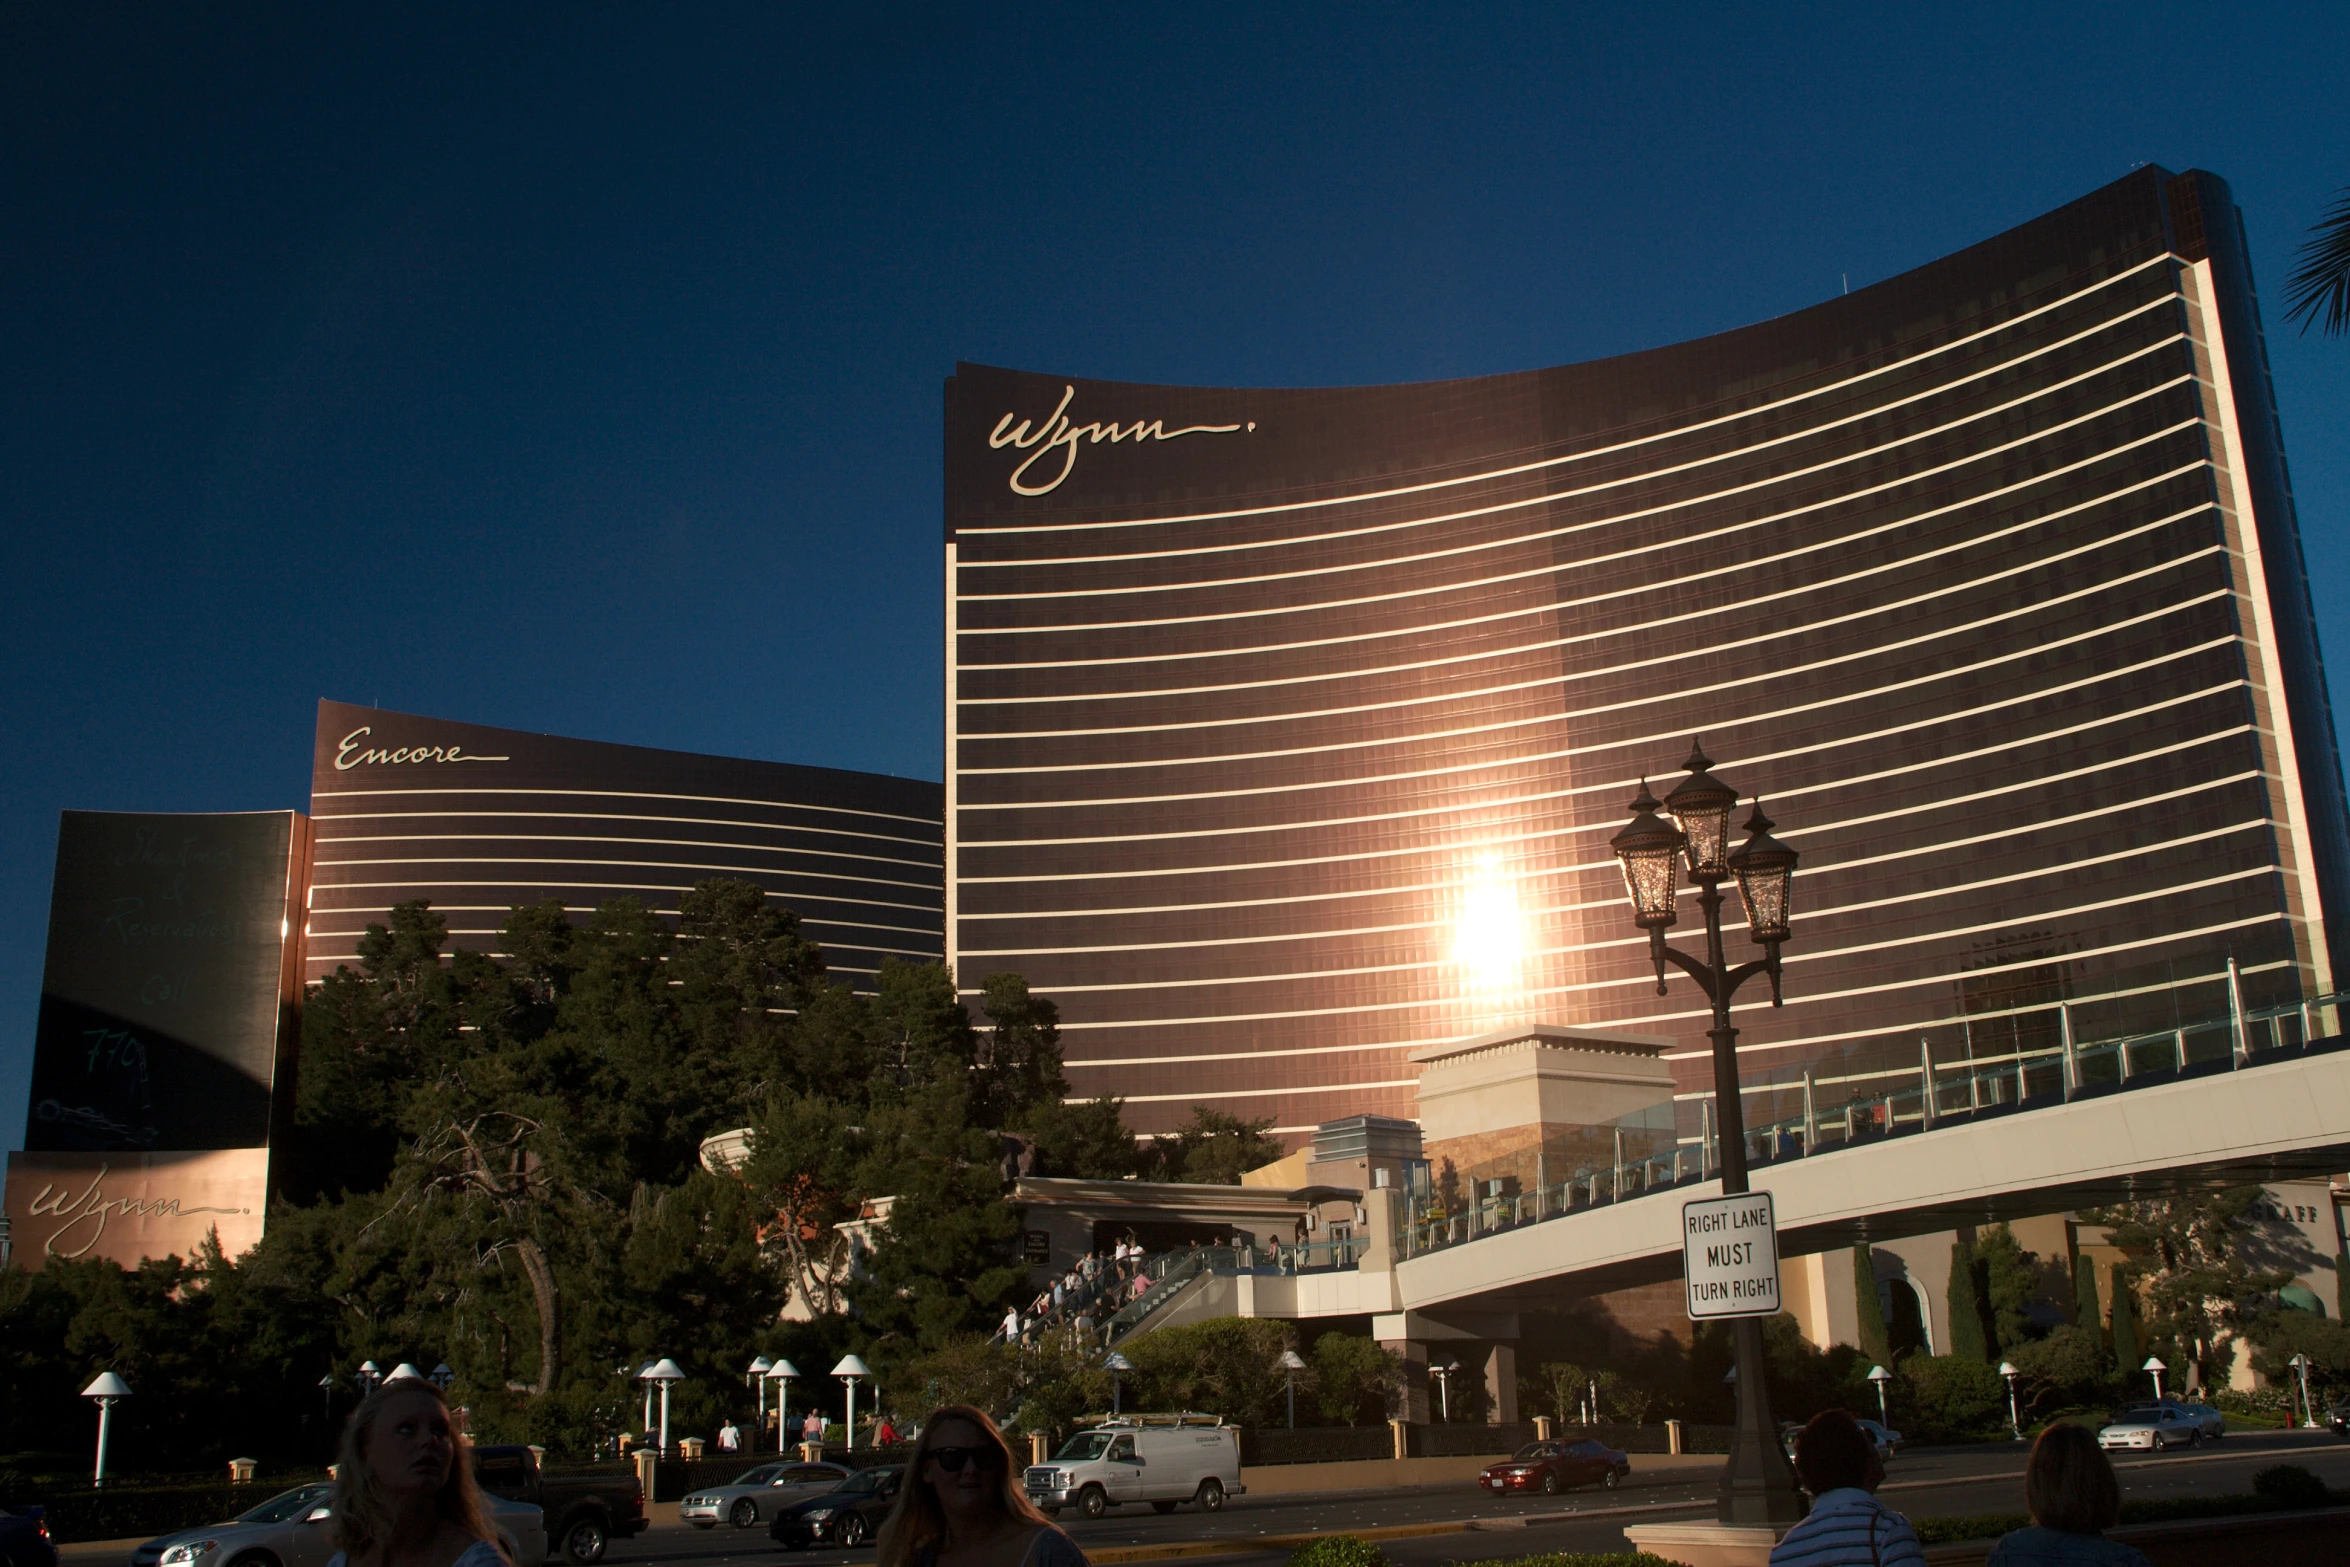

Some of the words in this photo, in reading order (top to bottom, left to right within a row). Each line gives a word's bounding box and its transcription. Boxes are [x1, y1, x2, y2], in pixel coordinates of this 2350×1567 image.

[334, 726, 511, 771] Encore
[1689, 1212, 1727, 1234] RIGHT
[1733, 1207, 1768, 1229] LANE
[2250, 1204, 2317, 1224] GRAFF
[1707, 1242, 1753, 1268] MUST
[1693, 1281, 1728, 1301] TURN
[1733, 1277, 1773, 1298] RIGHT
